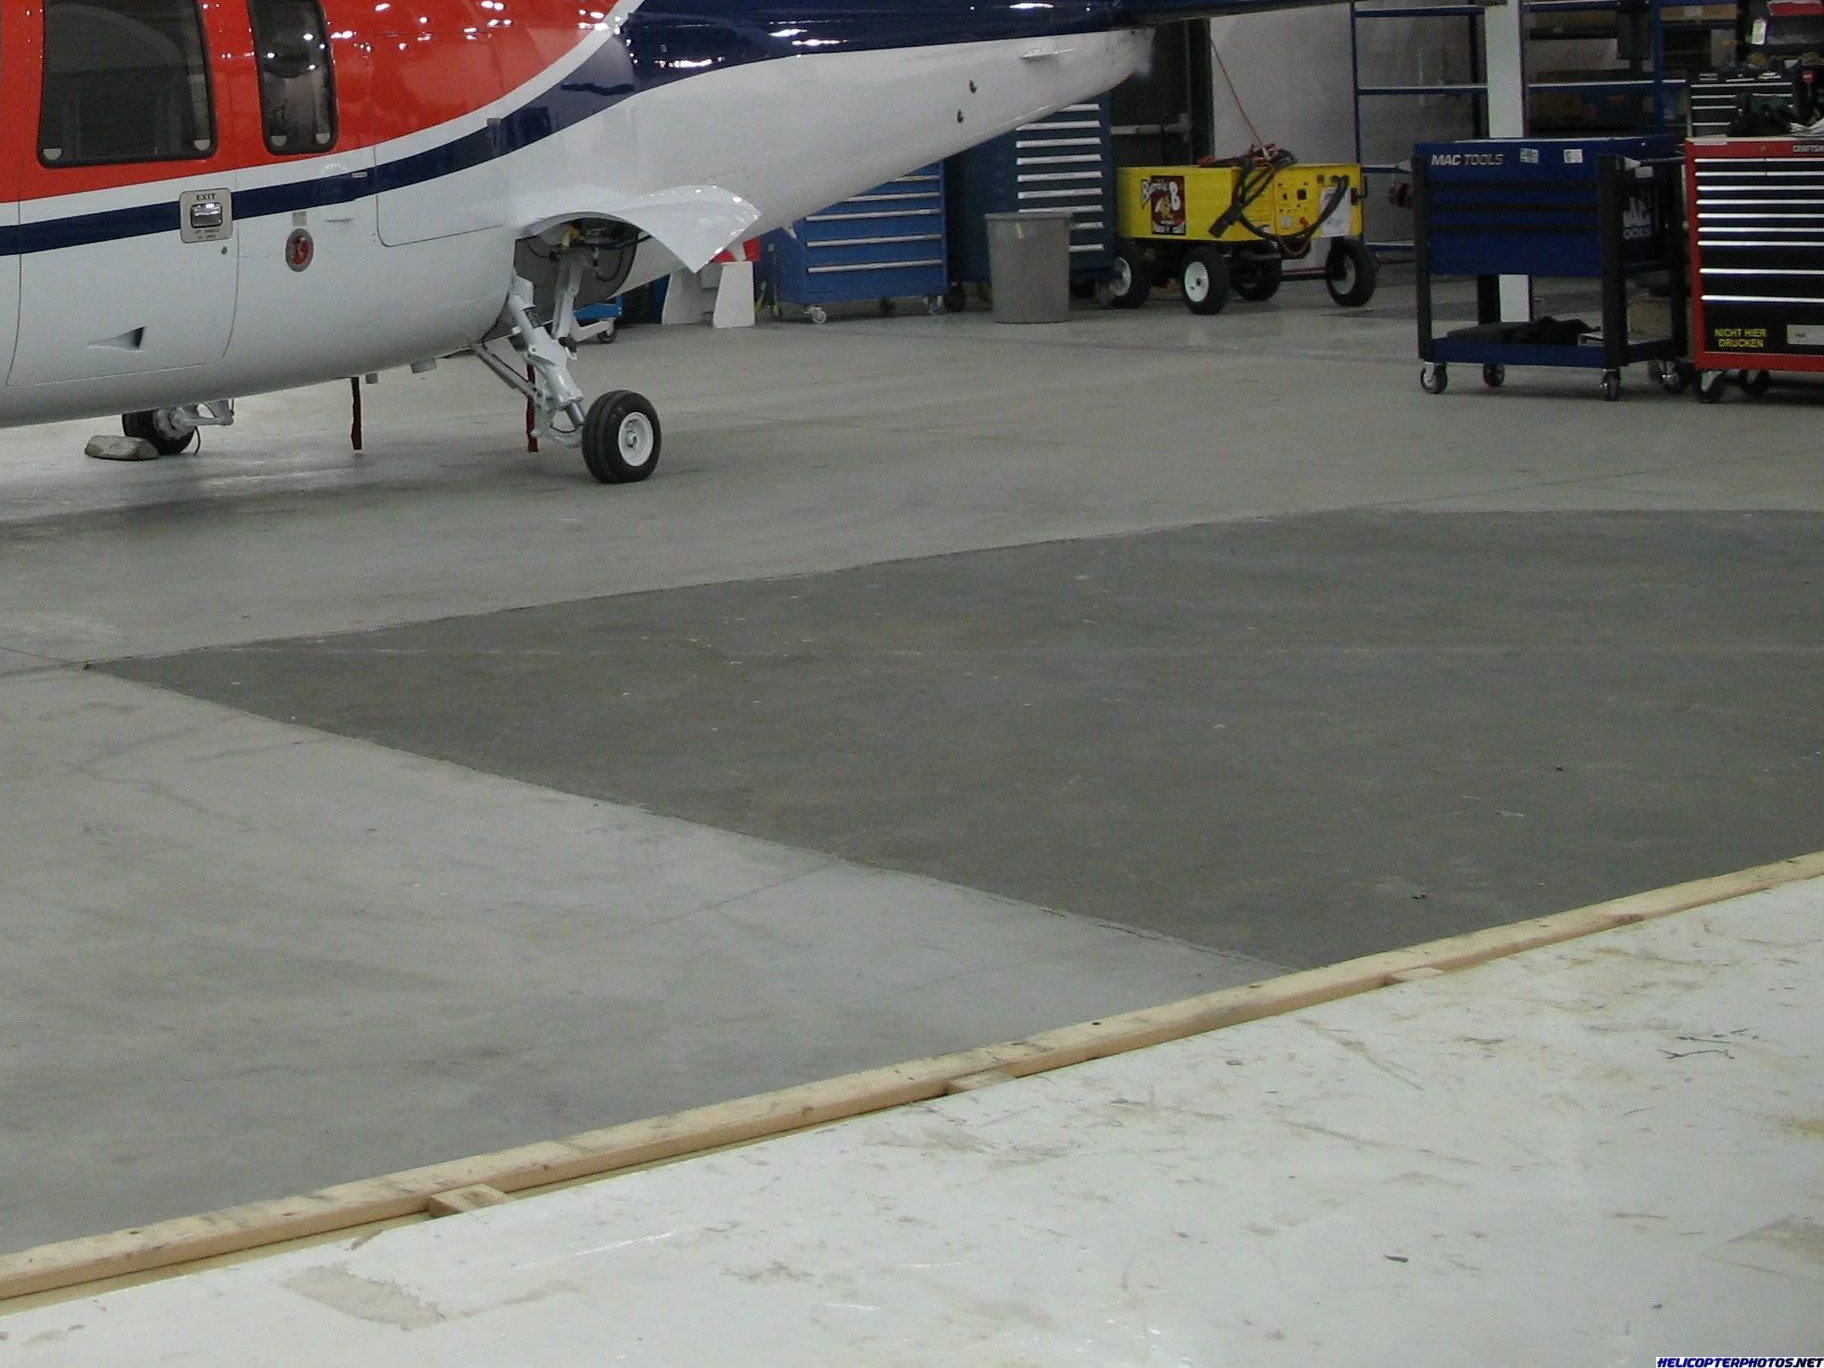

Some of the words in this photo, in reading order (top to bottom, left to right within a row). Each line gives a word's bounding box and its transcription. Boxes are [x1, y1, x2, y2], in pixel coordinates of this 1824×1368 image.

[1430, 155, 1462, 166] MAC
[1464, 154, 1505, 165] TOOLS
[196, 193, 216, 201] EXIT
